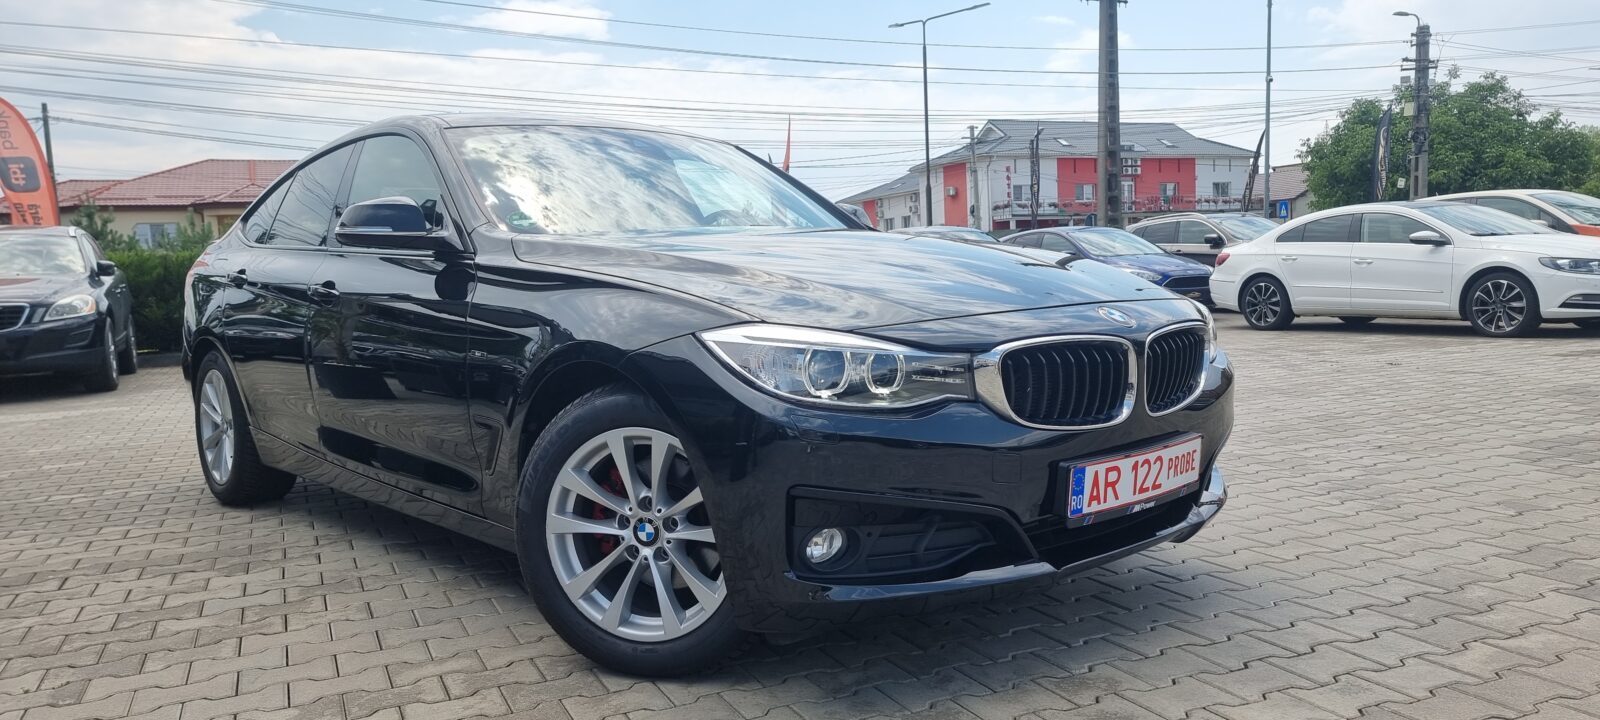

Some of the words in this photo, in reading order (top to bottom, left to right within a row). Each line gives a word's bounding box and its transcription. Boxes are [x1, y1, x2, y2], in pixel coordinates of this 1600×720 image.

[1087, 465, 1121, 507] AR
[1131, 455, 1164, 496] 122
[1167, 449, 1197, 480] PROBE
[1071, 494, 1083, 510] RO
